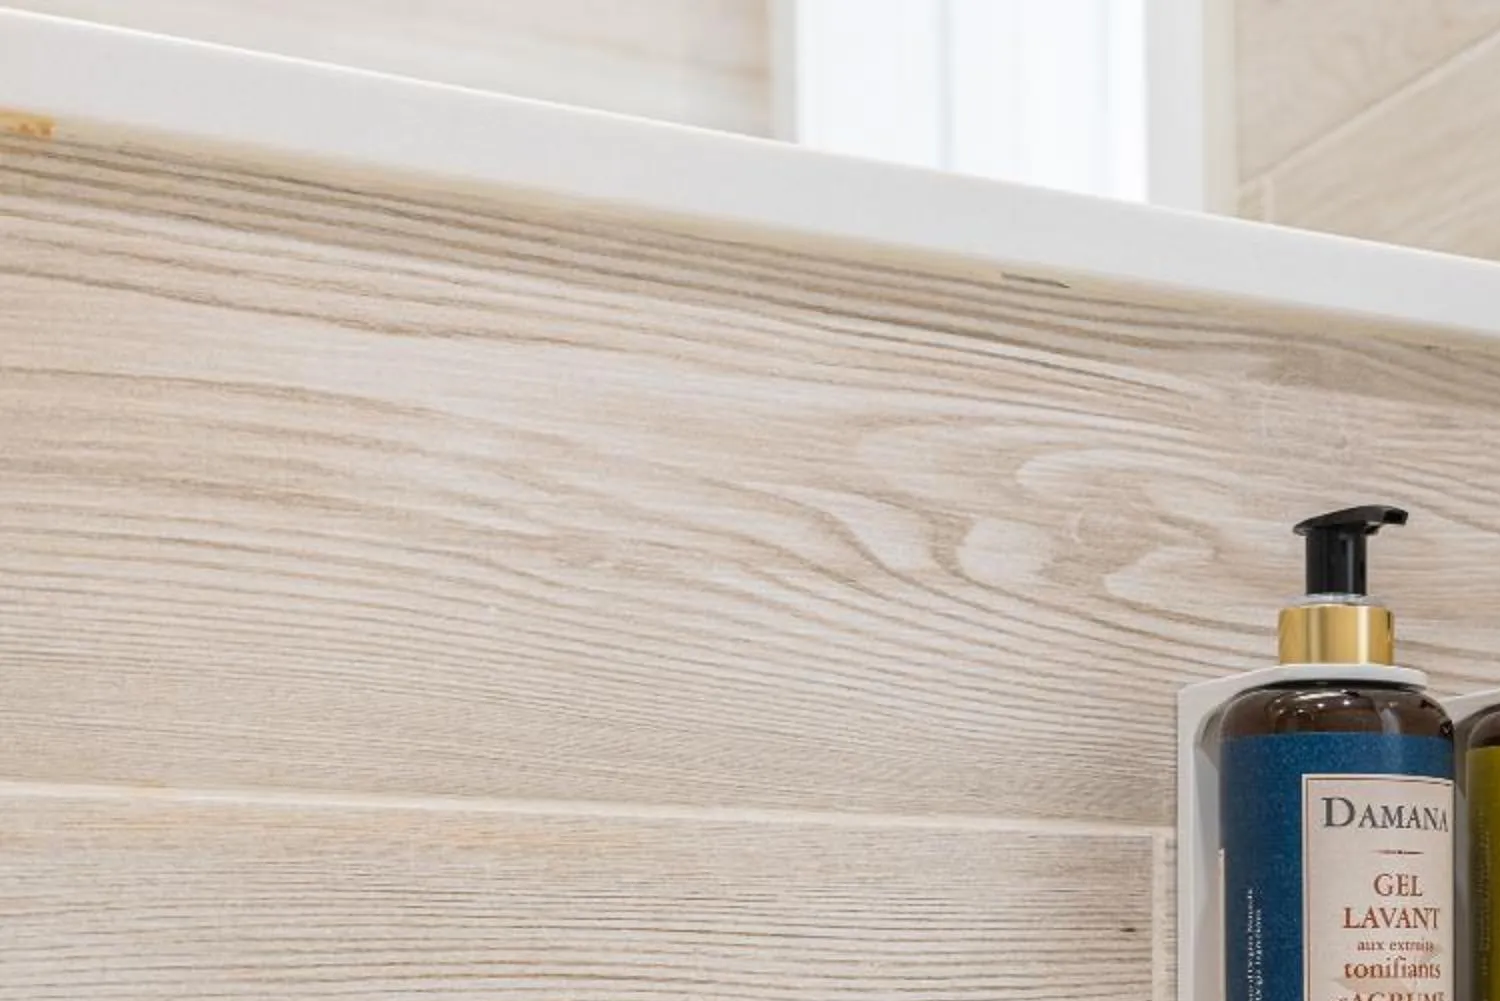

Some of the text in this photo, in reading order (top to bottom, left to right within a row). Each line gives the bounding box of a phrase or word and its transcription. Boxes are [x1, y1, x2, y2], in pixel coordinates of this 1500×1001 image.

[1321, 797, 1449, 833] DAMANA
[1373, 873, 1423, 897] GEL
[1343, 907, 1441, 930] LAVANT
[1357, 941, 1384, 951] aux
[1344, 956, 1441, 979] tonifiants
